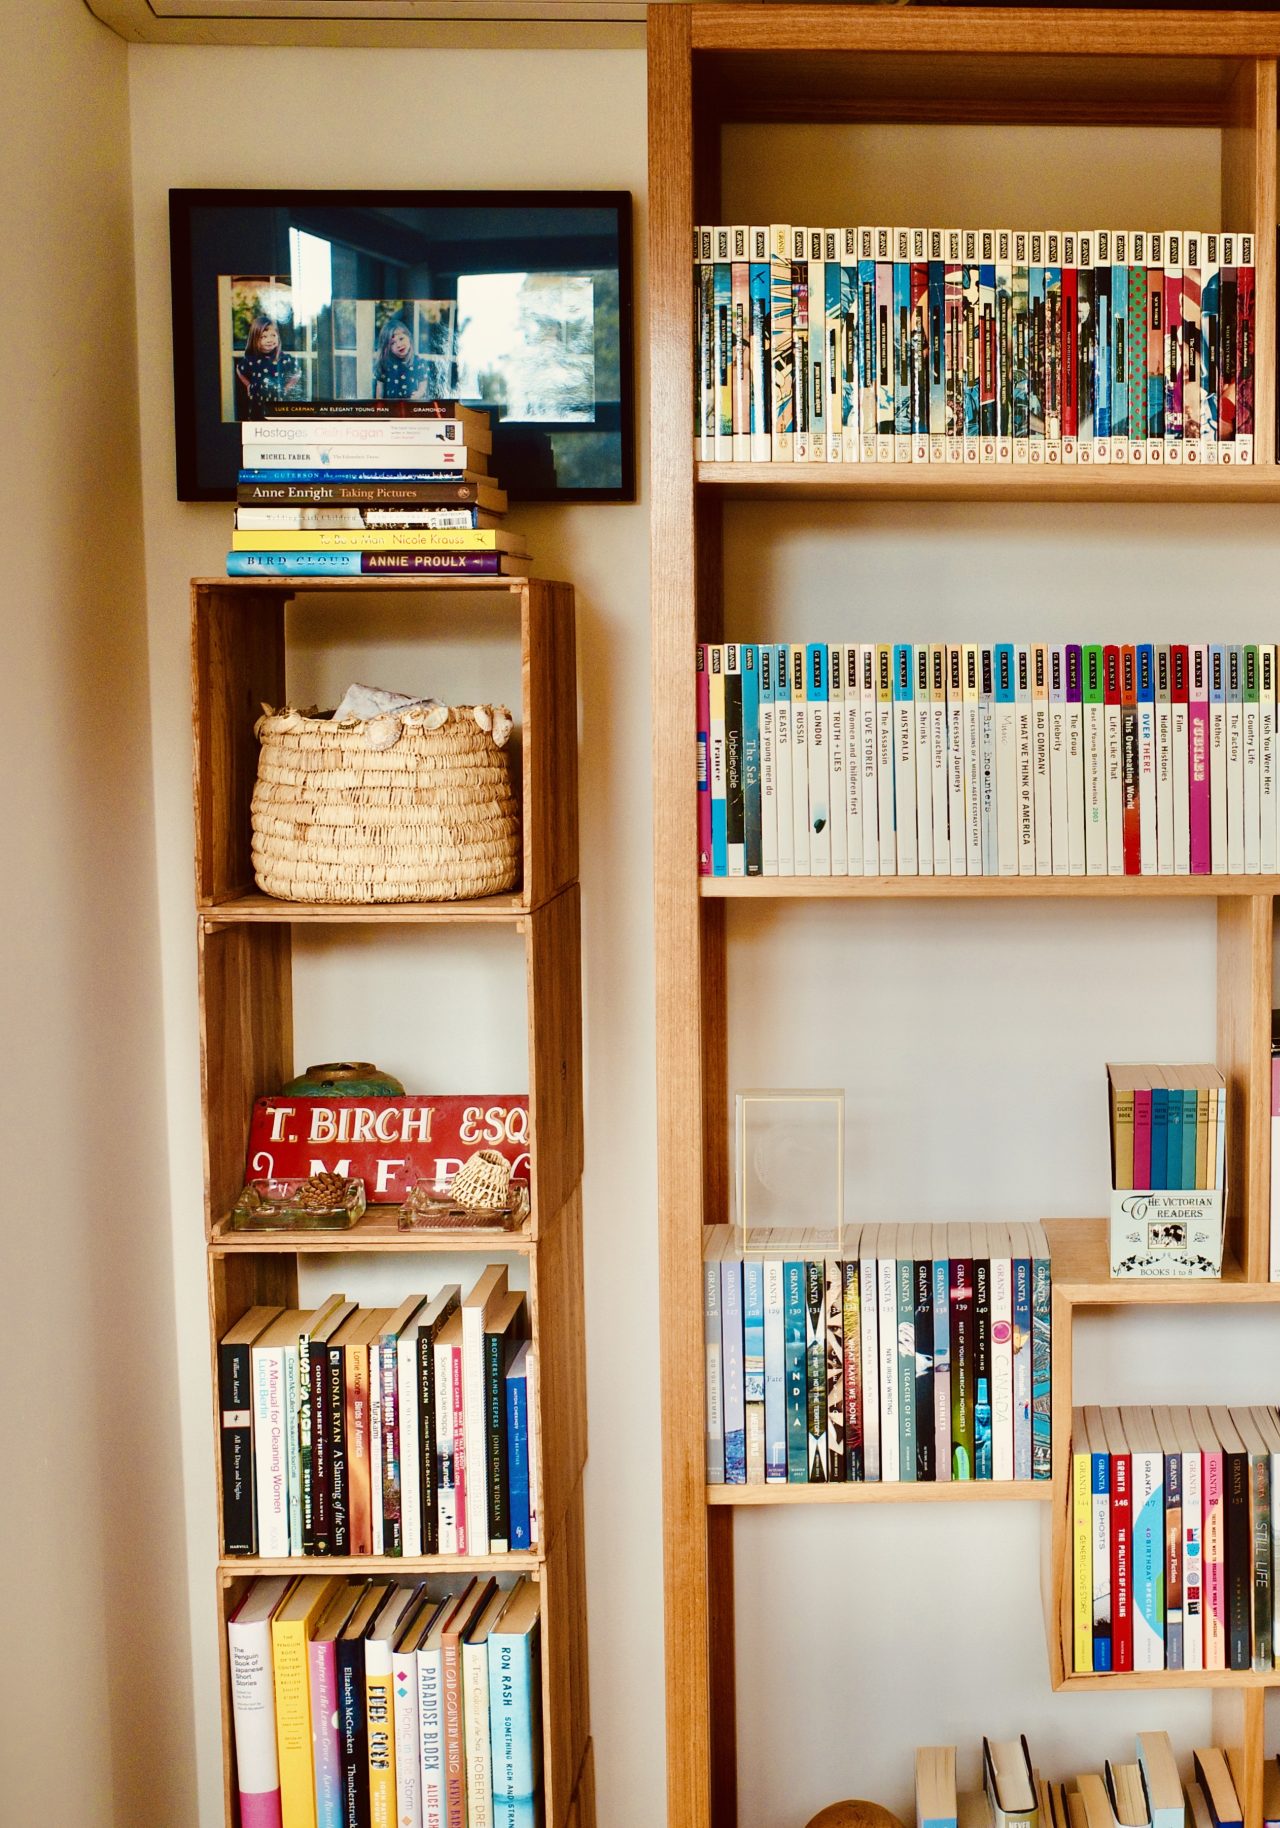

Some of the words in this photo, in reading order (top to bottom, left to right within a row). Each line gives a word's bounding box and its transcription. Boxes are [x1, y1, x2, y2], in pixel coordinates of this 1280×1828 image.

[253, 488, 284, 499] Anne
[288, 488, 333, 499] Enright
[340, 489, 374, 498] Taking
[376, 489, 416, 498] Pictures
[393, 535, 427, 544] Nicole
[430, 535, 464, 544] Krauss
[369, 556, 408, 567] ANNIE
[413, 556, 466, 567] PROULX
[1020, 715, 1029, 740] WHAT
[1125, 715, 1134, 733] This
[729, 730, 739, 788] Unbelievable
[1021, 742, 1029, 756] WE
[1125, 734, 1135, 783] Overheating
[1021, 758, 1029, 787] THINK
[1022, 789, 1030, 801] OF
[1126, 784, 1135, 809] World
[1022, 803, 1030, 845] AMERICA
[266, 1107, 297, 1142] T.
[308, 1107, 435, 1144] BIRCH
[459, 1107, 529, 1145] ESQ
[1162, 1198, 1212, 1206] VICTORIAN
[1157, 1210, 1203, 1218] READERS
[902, 1266, 911, 1302] GRANTA
[978, 1267, 986, 1304] GRANTA
[1017, 1266, 1026, 1302] GRANTA
[980, 1341, 984, 1351] OF
[353, 1351, 362, 1370] Lorrie
[270, 1369, 281, 1407] Manual
[331, 1369, 340, 1408] DONAL
[354, 1372, 362, 1394] Moore
[316, 1395, 322, 1408] TO
[354, 1401, 364, 1419] Birds
[904, 1404, 911, 1414] OF
[270, 1409, 281, 1424] for
[332, 1411, 341, 1443] RYAN
[372, 1401, 380, 1439] Murakami
[233, 1435, 242, 1443] All
[233, 1444, 242, 1453] the
[270, 1426, 282, 1472] Cleaning
[355, 1427, 364, 1457] America
[234, 1454, 242, 1469] Days
[332, 1450, 342, 1458] A
[234, 1469, 242, 1480] and
[332, 1460, 344, 1499] Slanting
[1117, 1459, 1125, 1491] GRANTA
[234, 1481, 242, 1500] Nights
[271, 1473, 283, 1513] Women
[493, 1483, 501, 1521] WIDEMAN
[333, 1500, 344, 1511] of
[333, 1511, 344, 1525] the
[334, 1526, 345, 1546] Sun
[1255, 1522, 1267, 1554] STILL
[1118, 1577, 1126, 1586] OF
[1255, 1560, 1267, 1587] LIFE
[501, 1647, 512, 1669] RON
[344, 1667, 353, 1705] Elizabeth
[421, 1668, 437, 1726] PARADISE
[502, 1675, 513, 1706] RASH
[345, 1706, 354, 1754] McCracken
[423, 1731, 439, 1770] BLOCK
